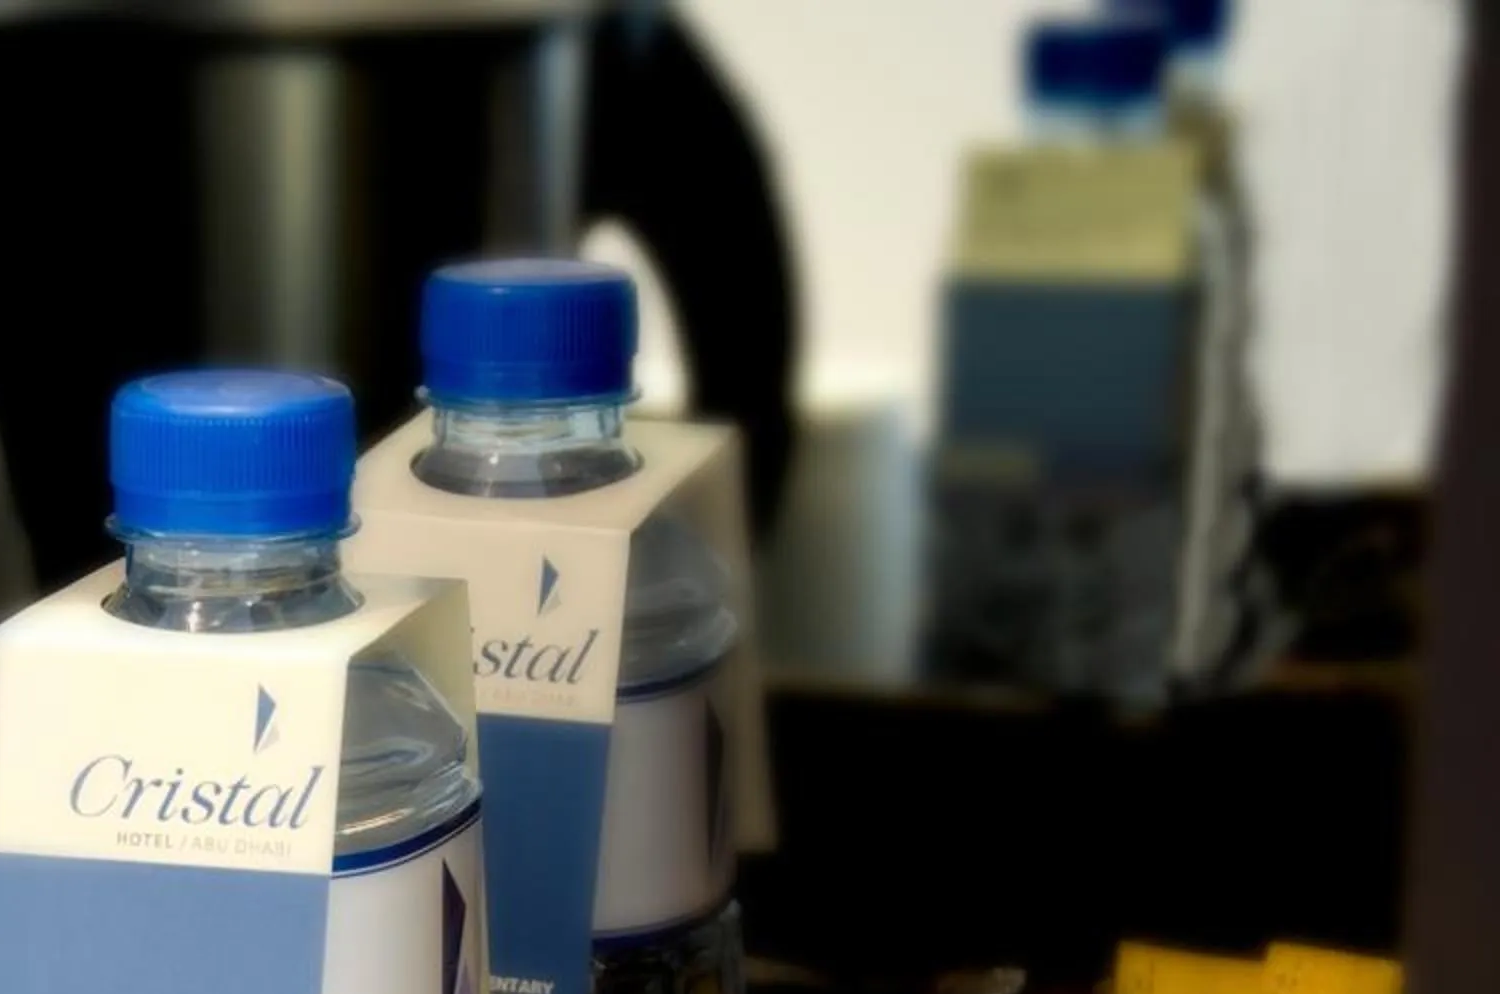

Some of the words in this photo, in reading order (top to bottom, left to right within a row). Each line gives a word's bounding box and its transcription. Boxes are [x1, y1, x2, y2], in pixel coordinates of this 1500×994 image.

[471, 628, 599, 684] stal
[70, 754, 325, 829] Cristal
[116, 831, 173, 849] HOTEL
[192, 836, 227, 853] ABU
[234, 839, 292, 857] DHABI
